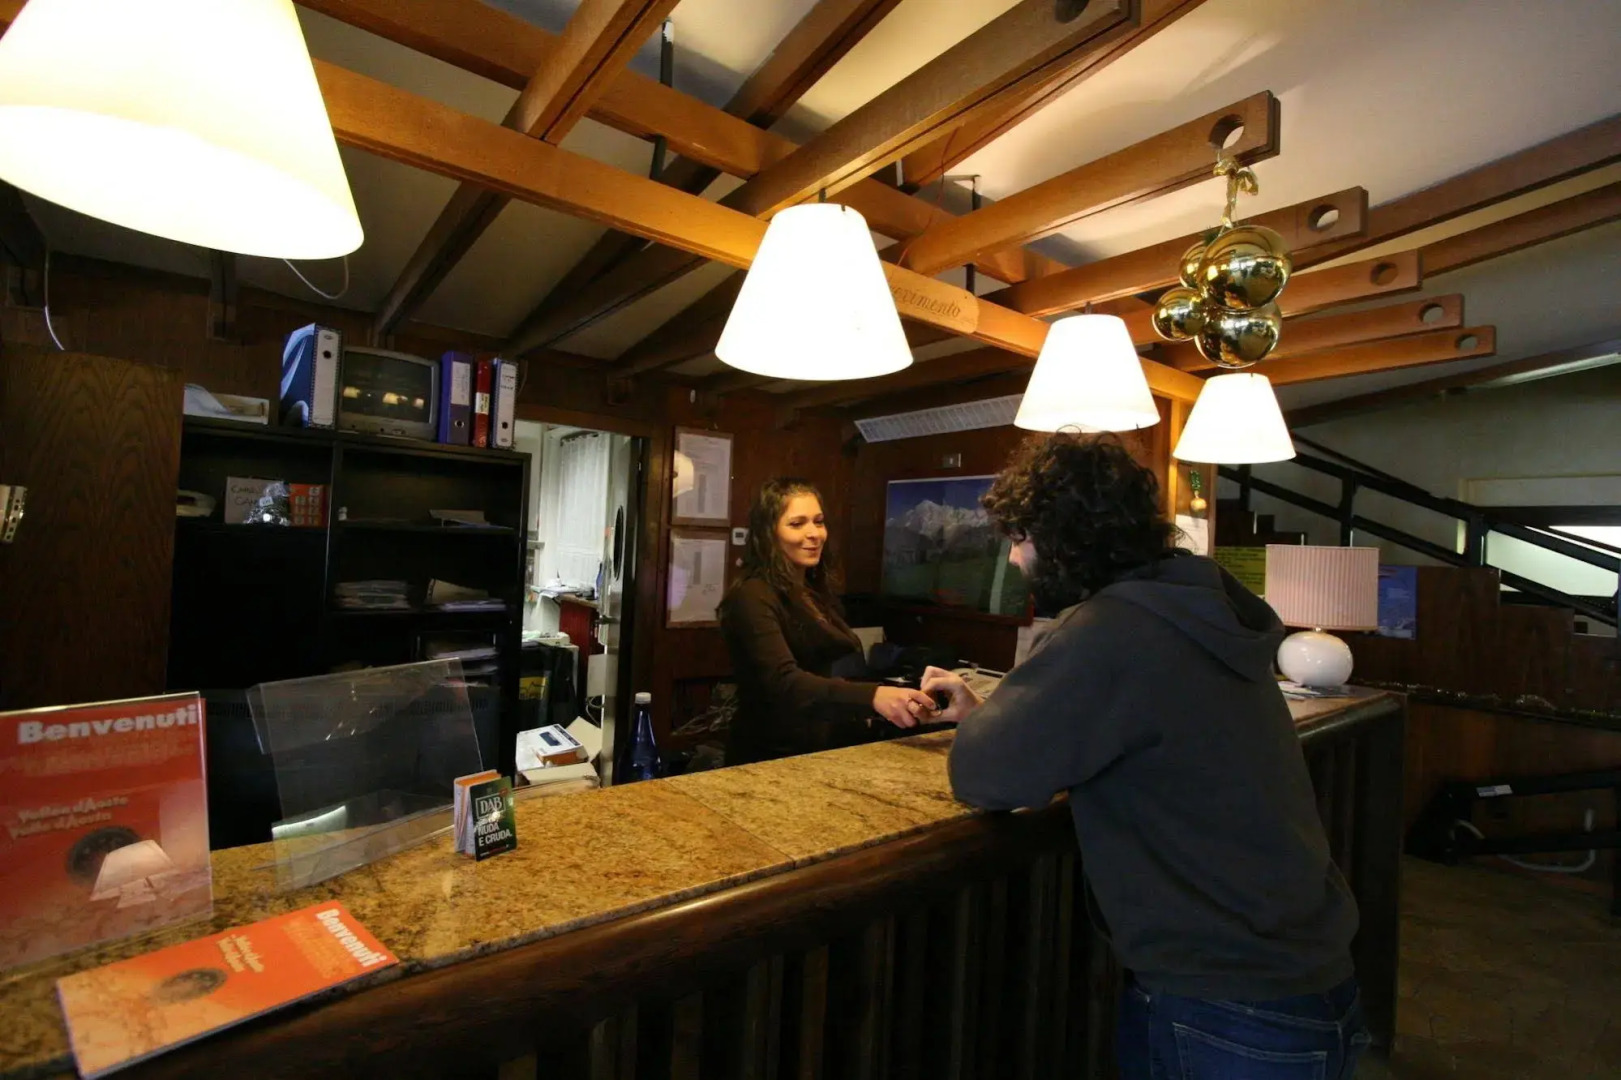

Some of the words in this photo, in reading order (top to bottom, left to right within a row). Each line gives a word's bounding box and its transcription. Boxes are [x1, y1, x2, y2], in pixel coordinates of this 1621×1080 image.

[17, 703, 198, 744] Benvenuti
[480, 796, 503, 814] DAB
[478, 822, 500, 836] NUDA
[478, 837, 485, 847] E
[315, 908, 388, 967] Benvenuti
